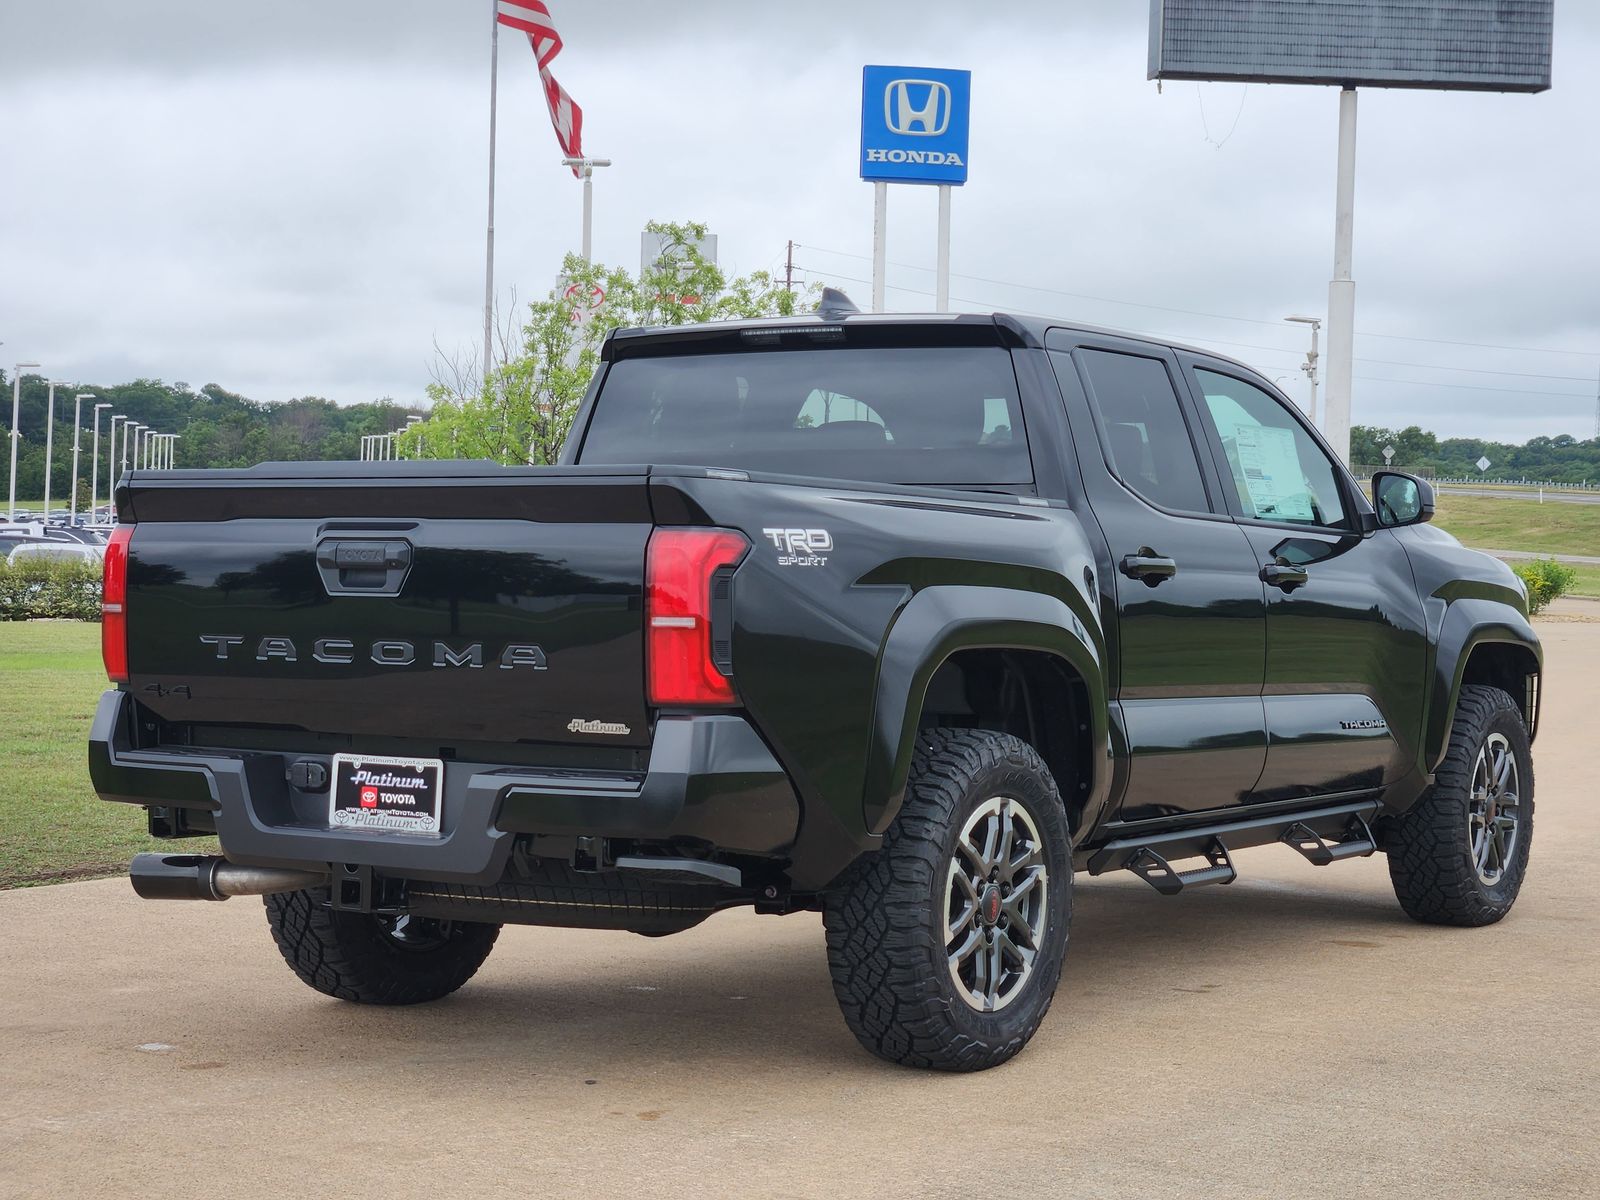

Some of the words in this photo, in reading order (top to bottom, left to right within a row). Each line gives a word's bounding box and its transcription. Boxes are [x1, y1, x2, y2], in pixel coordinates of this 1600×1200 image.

[866, 148, 964, 166] HONDA
[763, 527, 833, 556] TRD
[339, 549, 382, 561] TOYOTA
[778, 556, 827, 566] SPORT
[200, 635, 548, 671] TACOMA
[567, 718, 631, 735] Platinum
[1340, 720, 1386, 729] TACOMA
[339, 756, 438, 766] www.PlatinumToyota.com
[350, 770, 428, 789] Platinum
[380, 793, 416, 805] TOYOTA
[355, 813, 416, 829] Platinum
